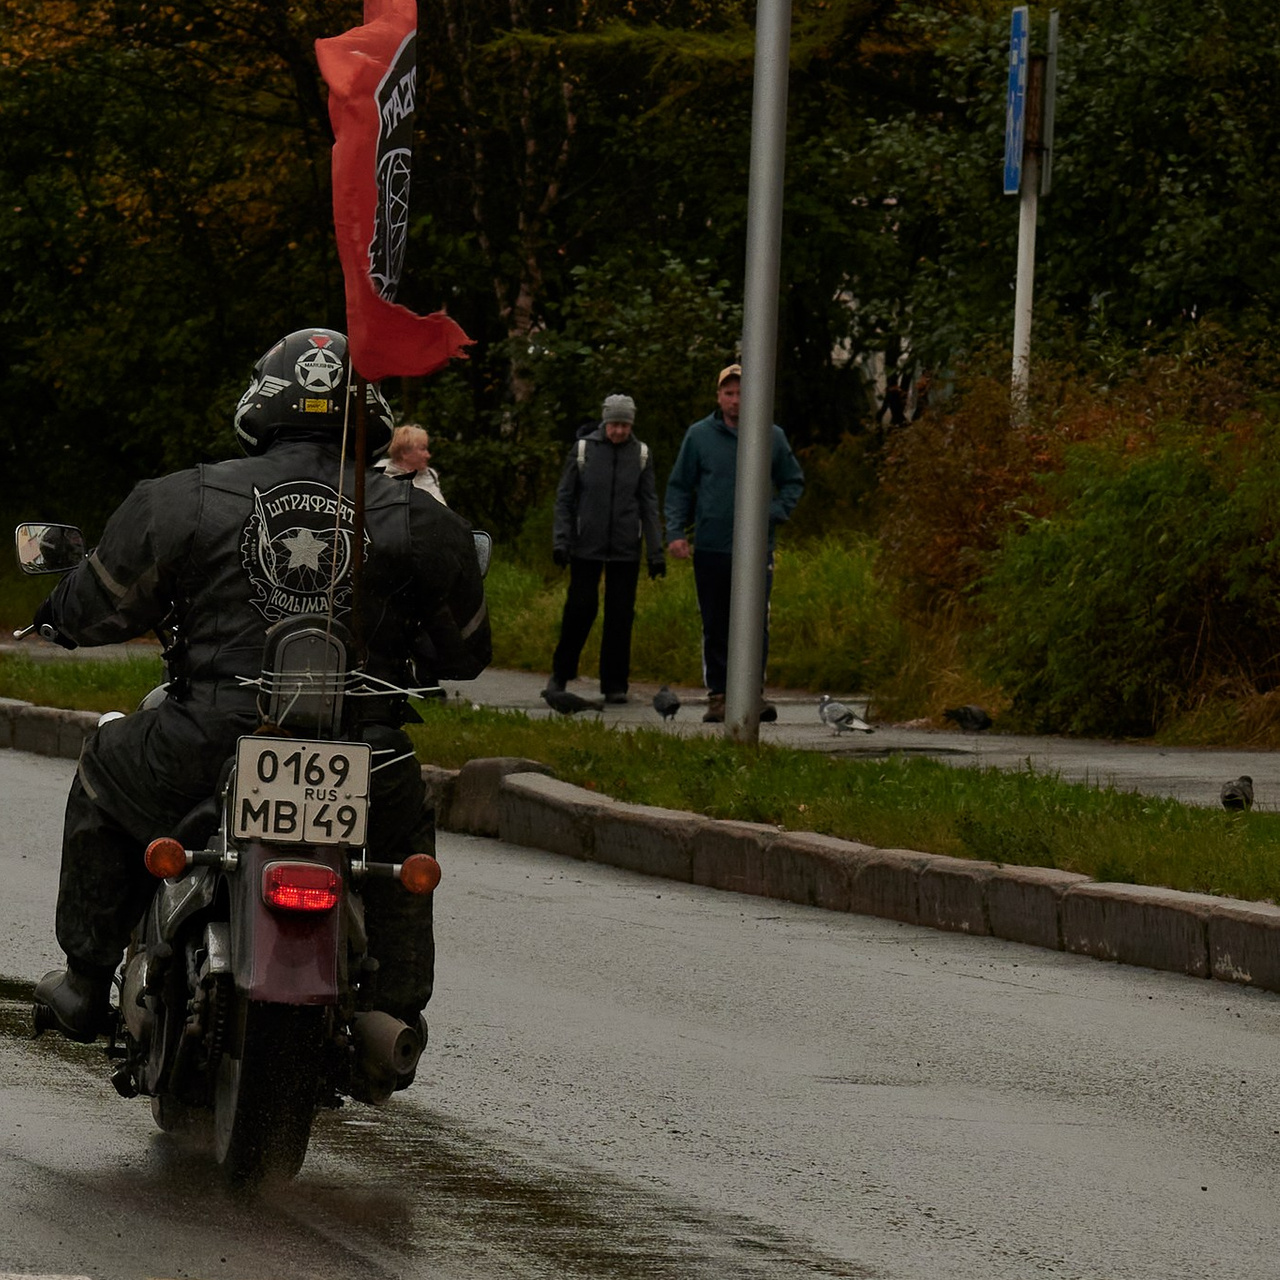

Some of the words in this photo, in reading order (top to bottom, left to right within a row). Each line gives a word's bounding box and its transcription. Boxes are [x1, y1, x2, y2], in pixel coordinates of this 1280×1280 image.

[265, 494, 356, 525] ШТРАФБАТ
[271, 589, 330, 613] КОЛЫМА
[257, 750, 350, 788] 0169
[304, 788, 337, 802] RUS
[240, 798, 298, 834] МВ
[312, 804, 357, 838] 49
